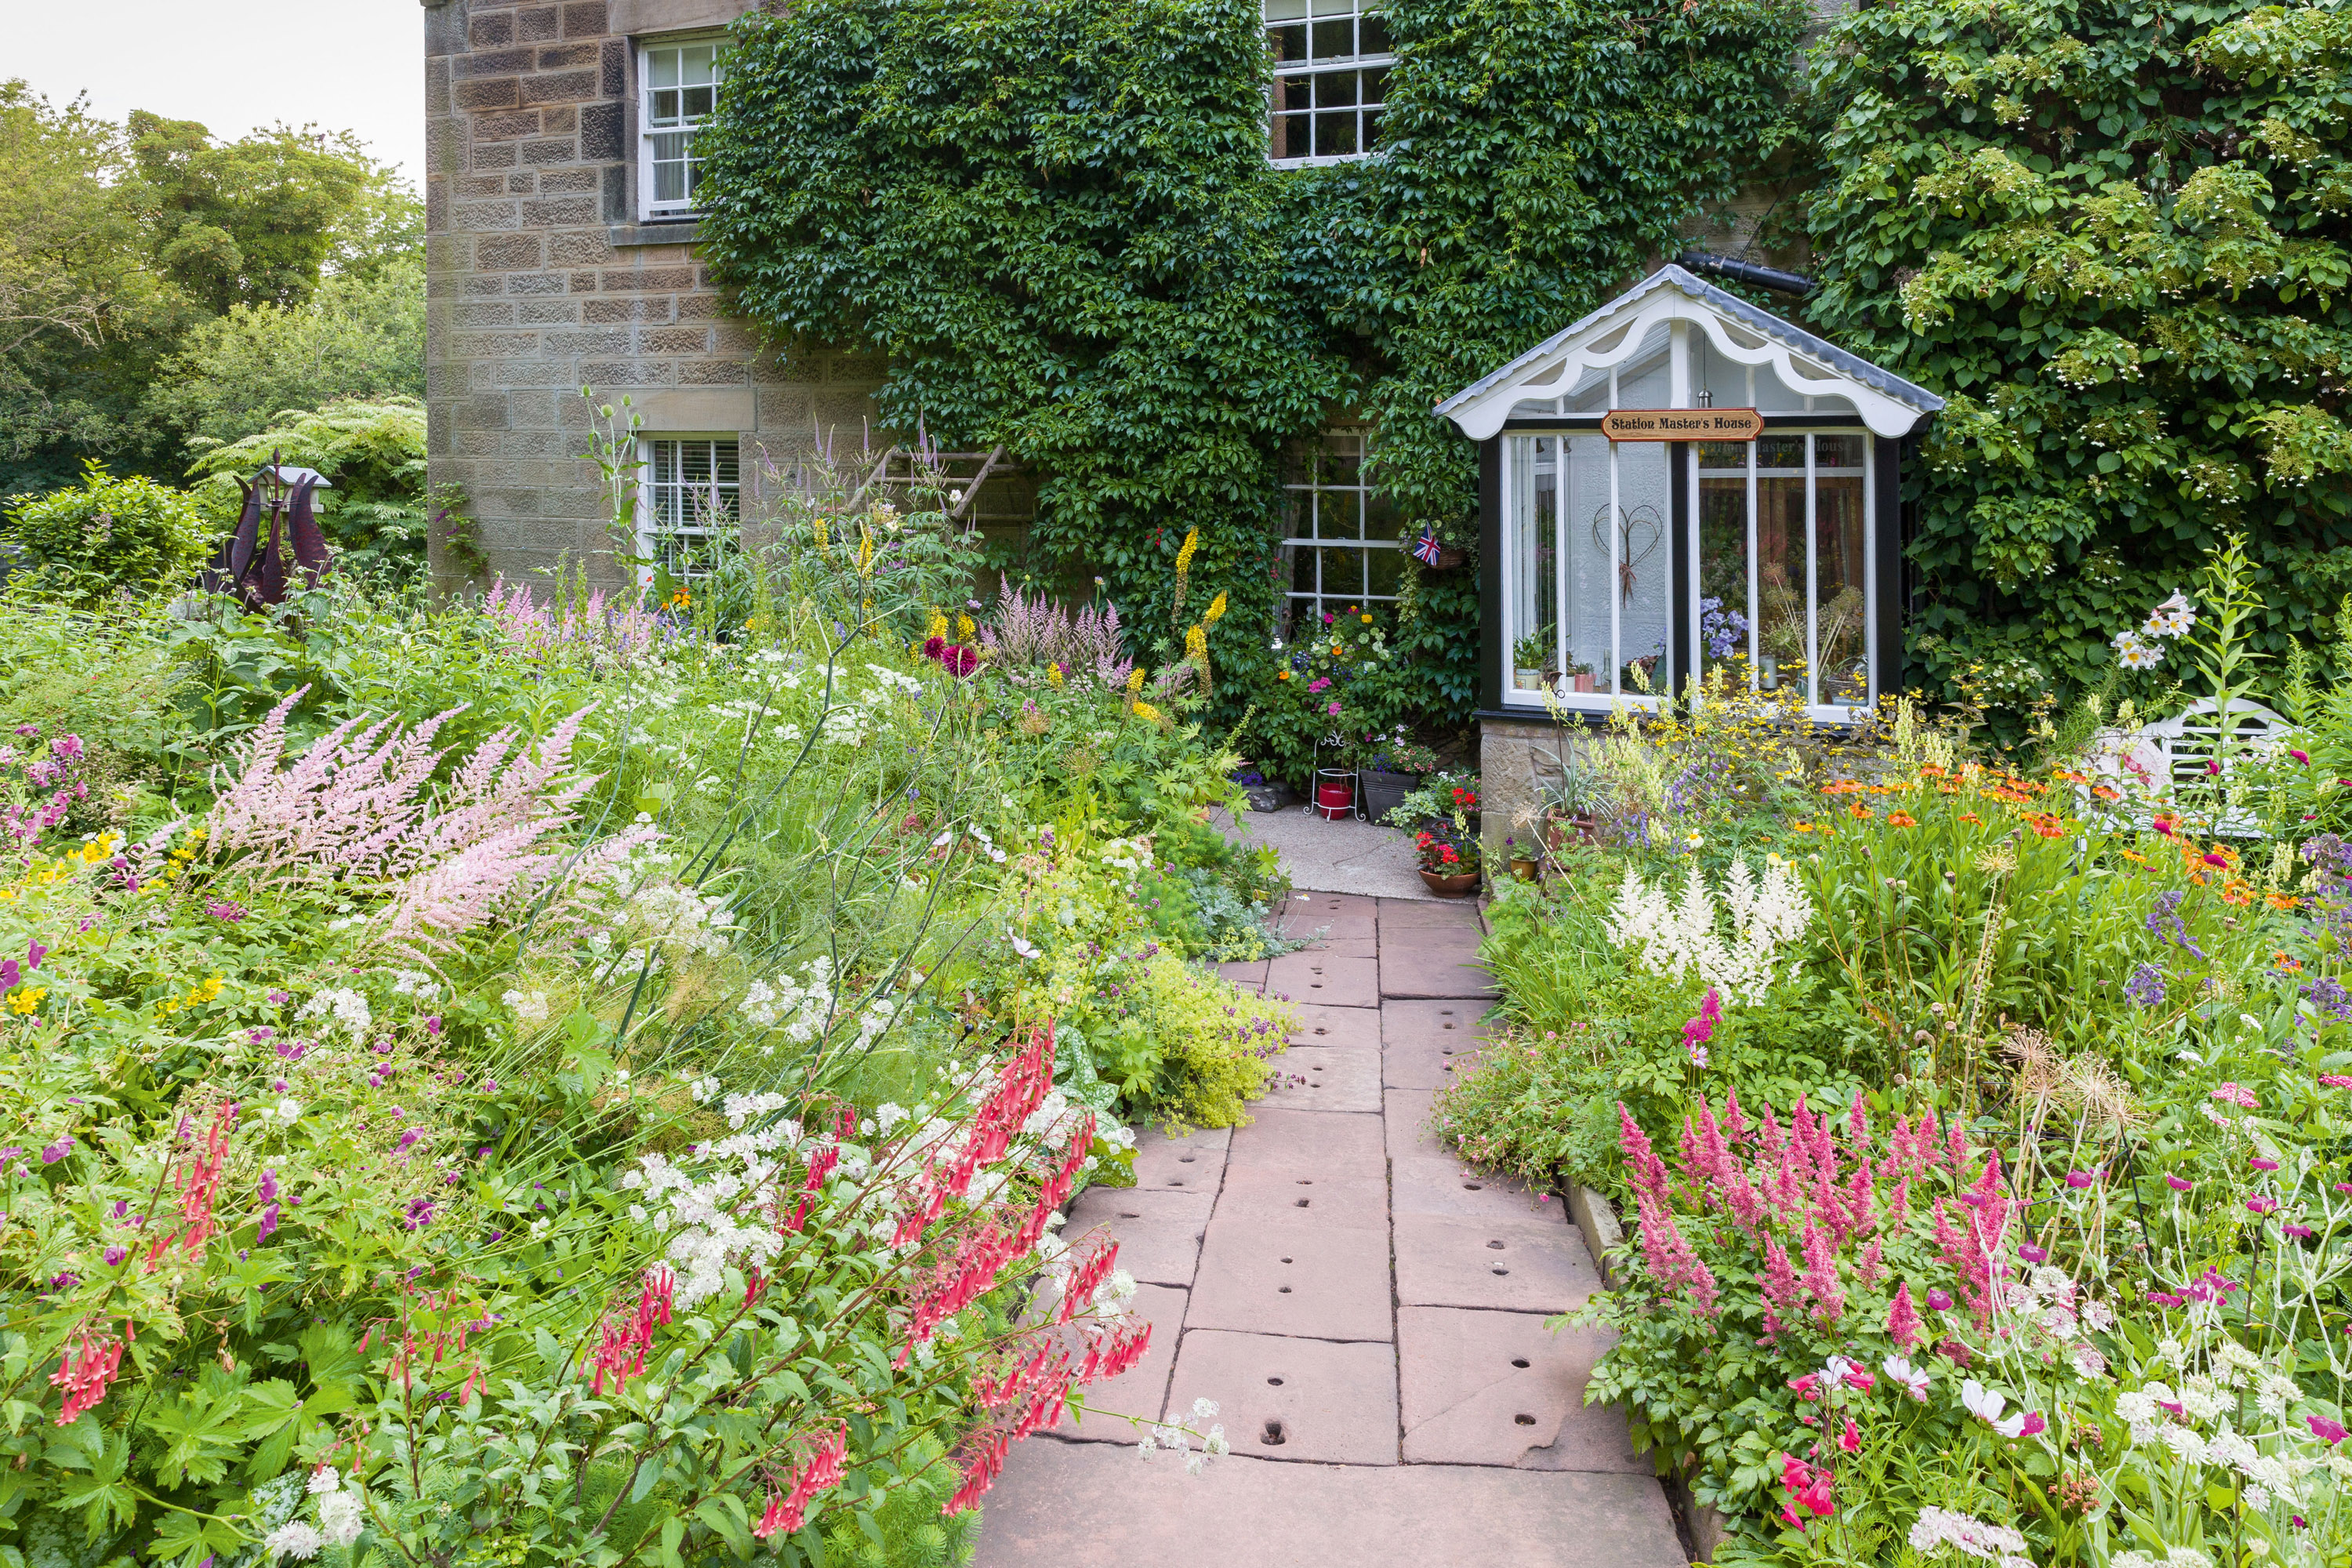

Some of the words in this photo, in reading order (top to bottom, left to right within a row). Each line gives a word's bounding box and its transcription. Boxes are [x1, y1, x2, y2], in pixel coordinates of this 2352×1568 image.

[1611, 417, 1655, 430] Station
[1659, 418, 1710, 429] Master's
[1714, 417, 1751, 429] House
